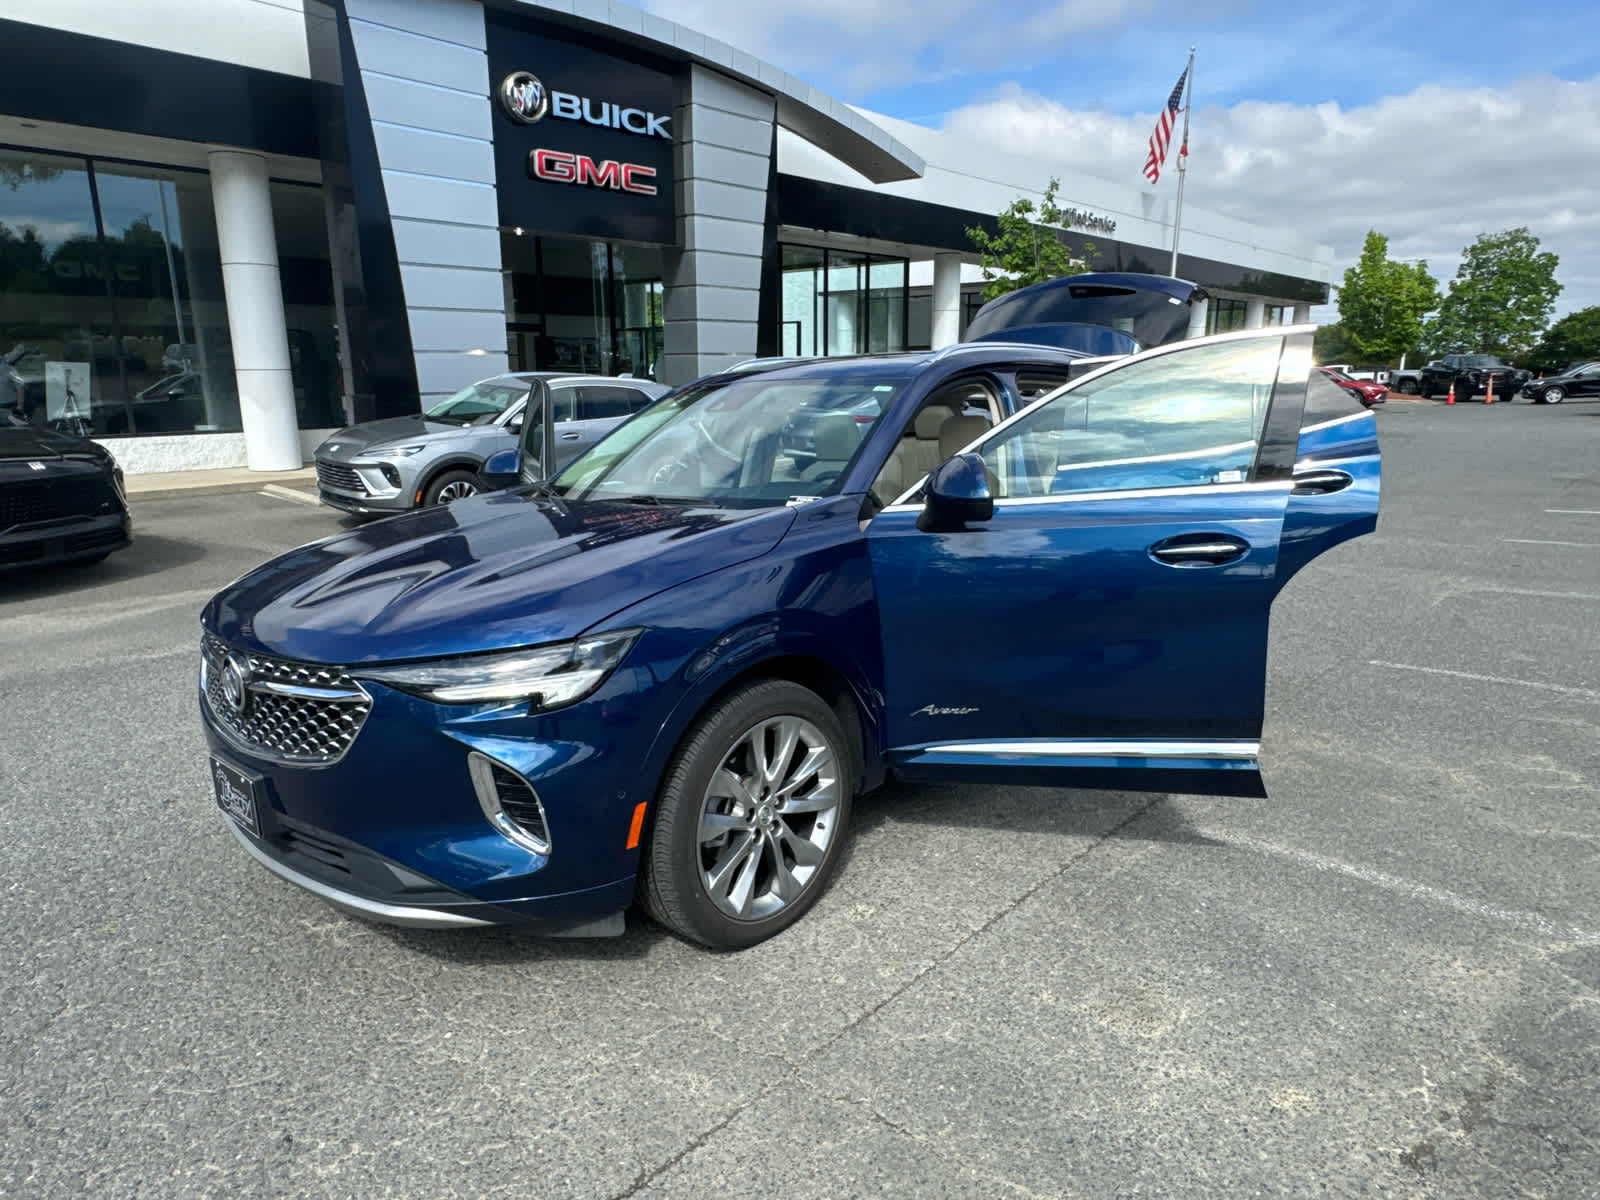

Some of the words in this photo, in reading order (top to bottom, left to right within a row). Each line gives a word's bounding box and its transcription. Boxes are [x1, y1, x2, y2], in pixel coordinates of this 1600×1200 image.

[551, 91, 673, 139] BUICK
[529, 149, 657, 195] GMC
[1087, 211, 1117, 233] Service
